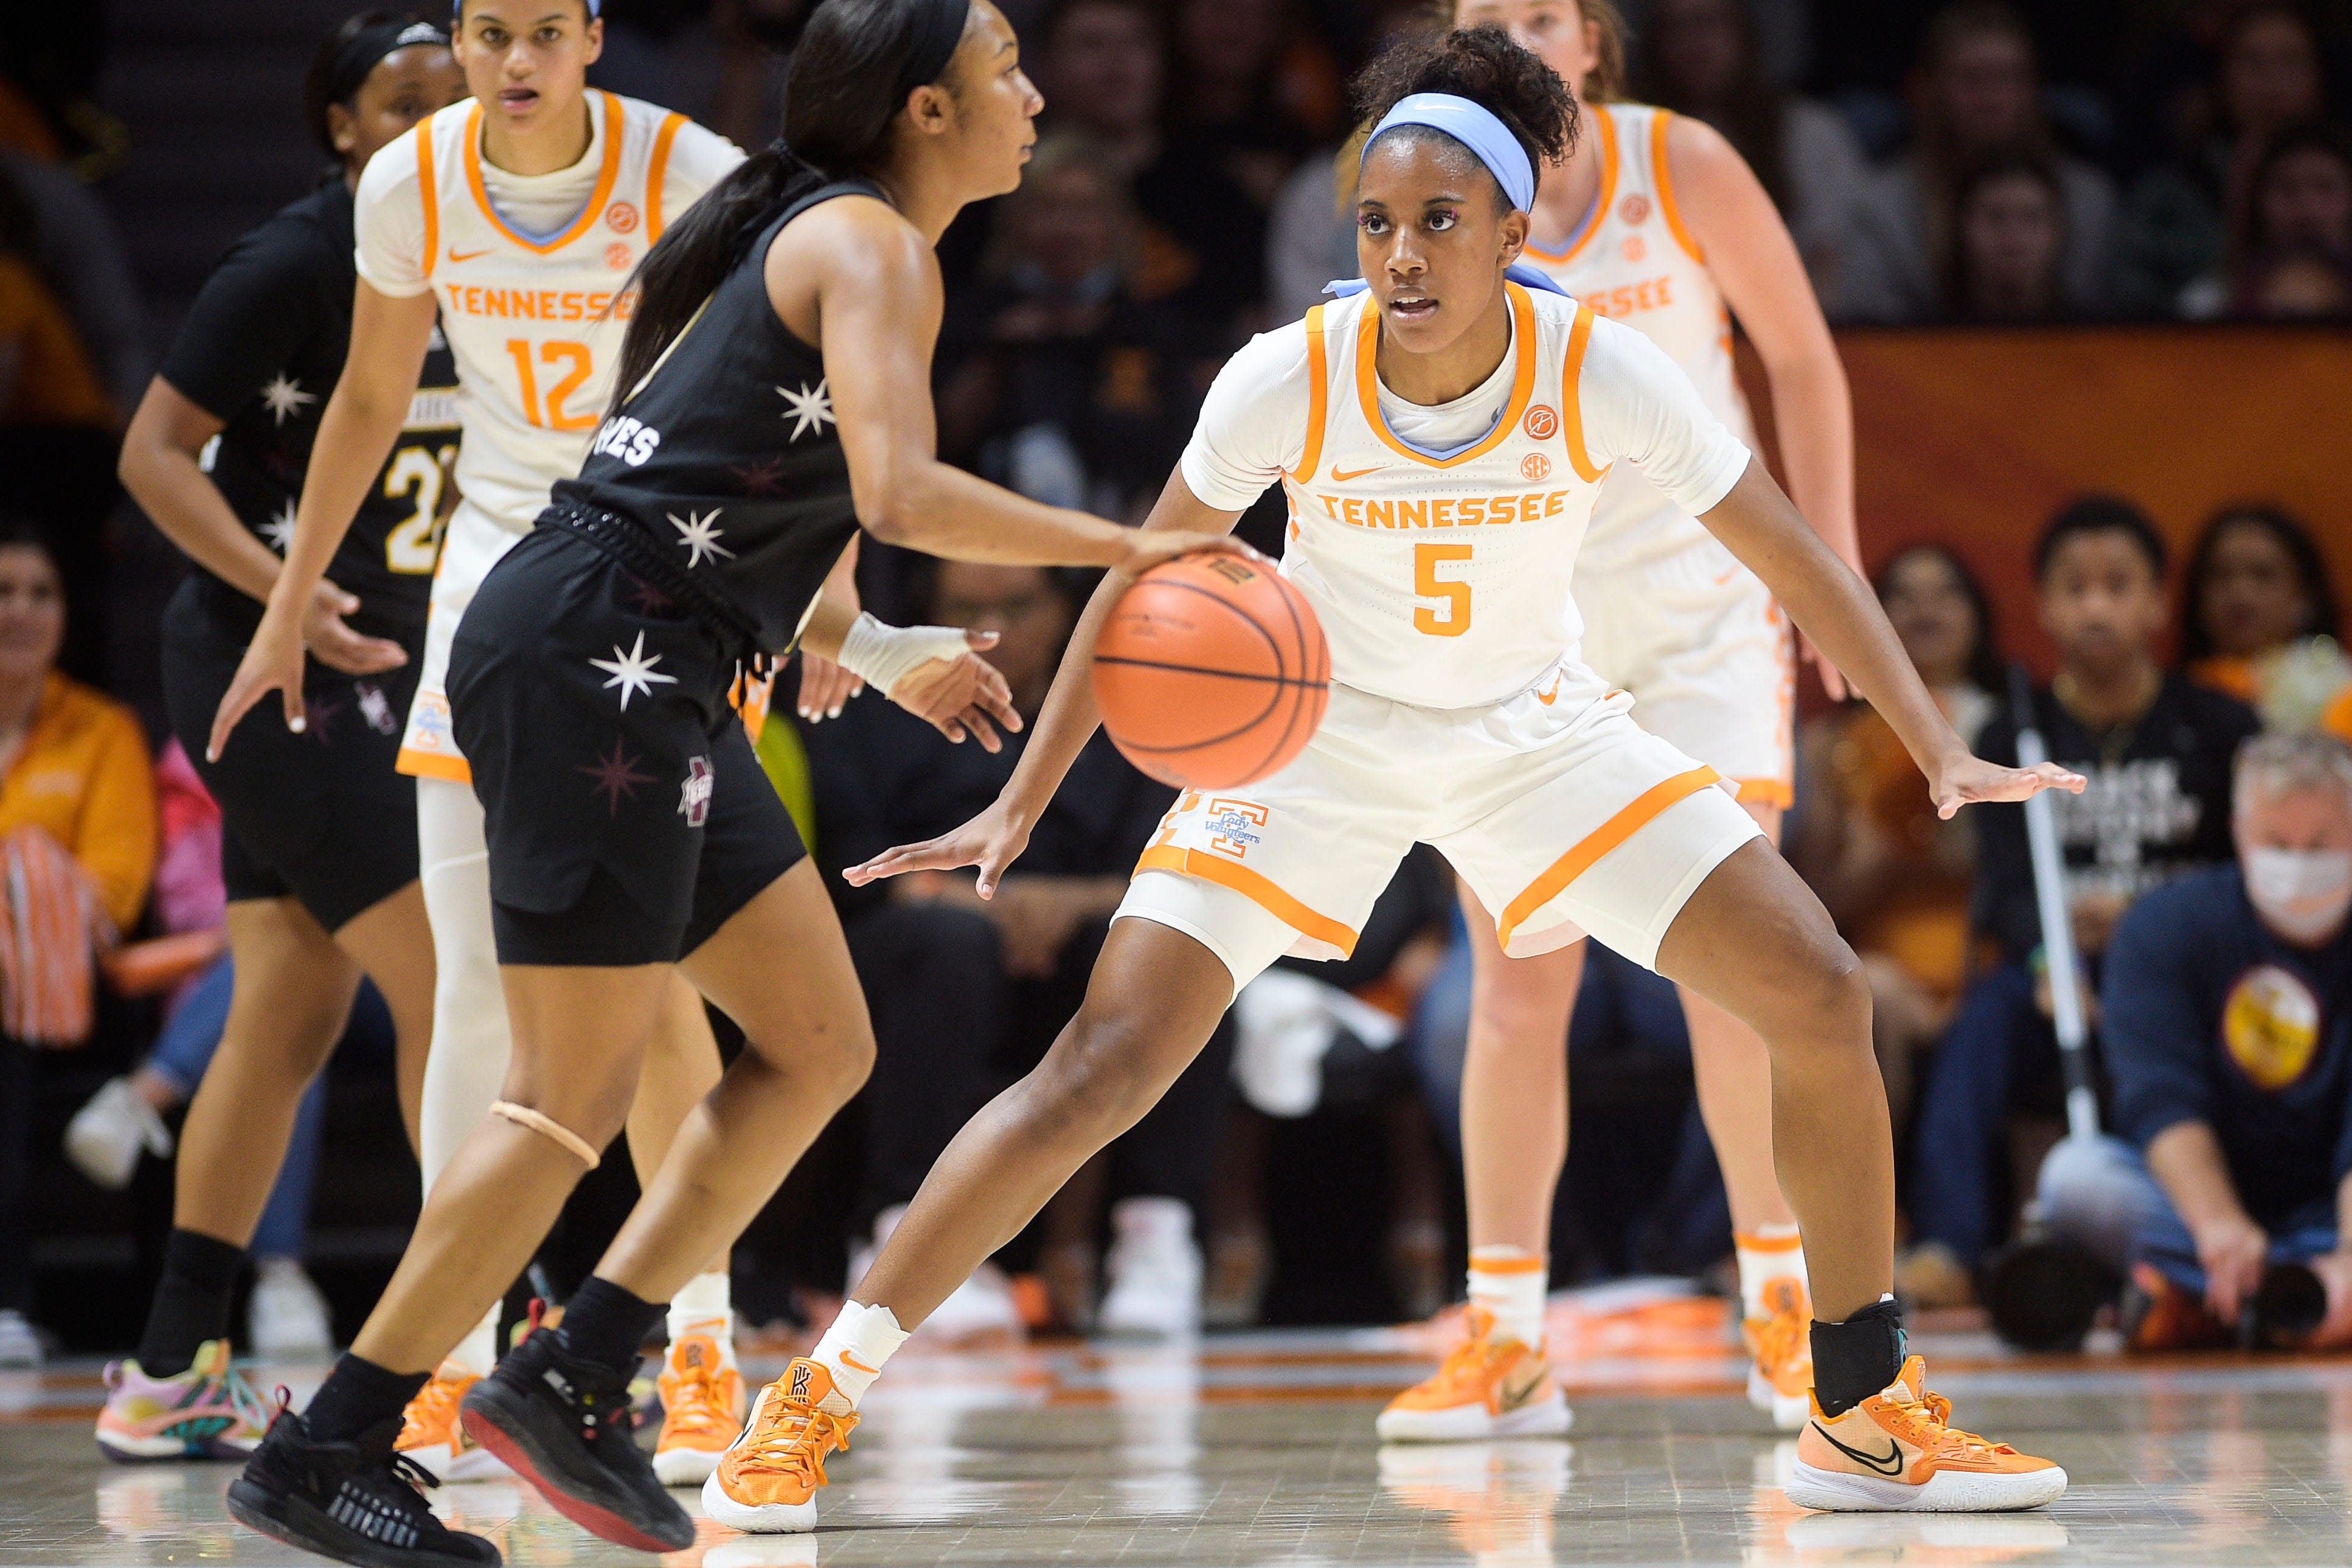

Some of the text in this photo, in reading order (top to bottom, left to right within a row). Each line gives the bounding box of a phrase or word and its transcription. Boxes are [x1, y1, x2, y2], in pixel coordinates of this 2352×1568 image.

[506, 339, 599, 431] 12
[1523, 454, 1549, 479] SEC
[1317, 490, 1570, 530] TENNESSEE
[1414, 543, 1473, 637] 5
[1205, 821, 1261, 844] Volunteers
[1222, 813, 1249, 830] Lady
